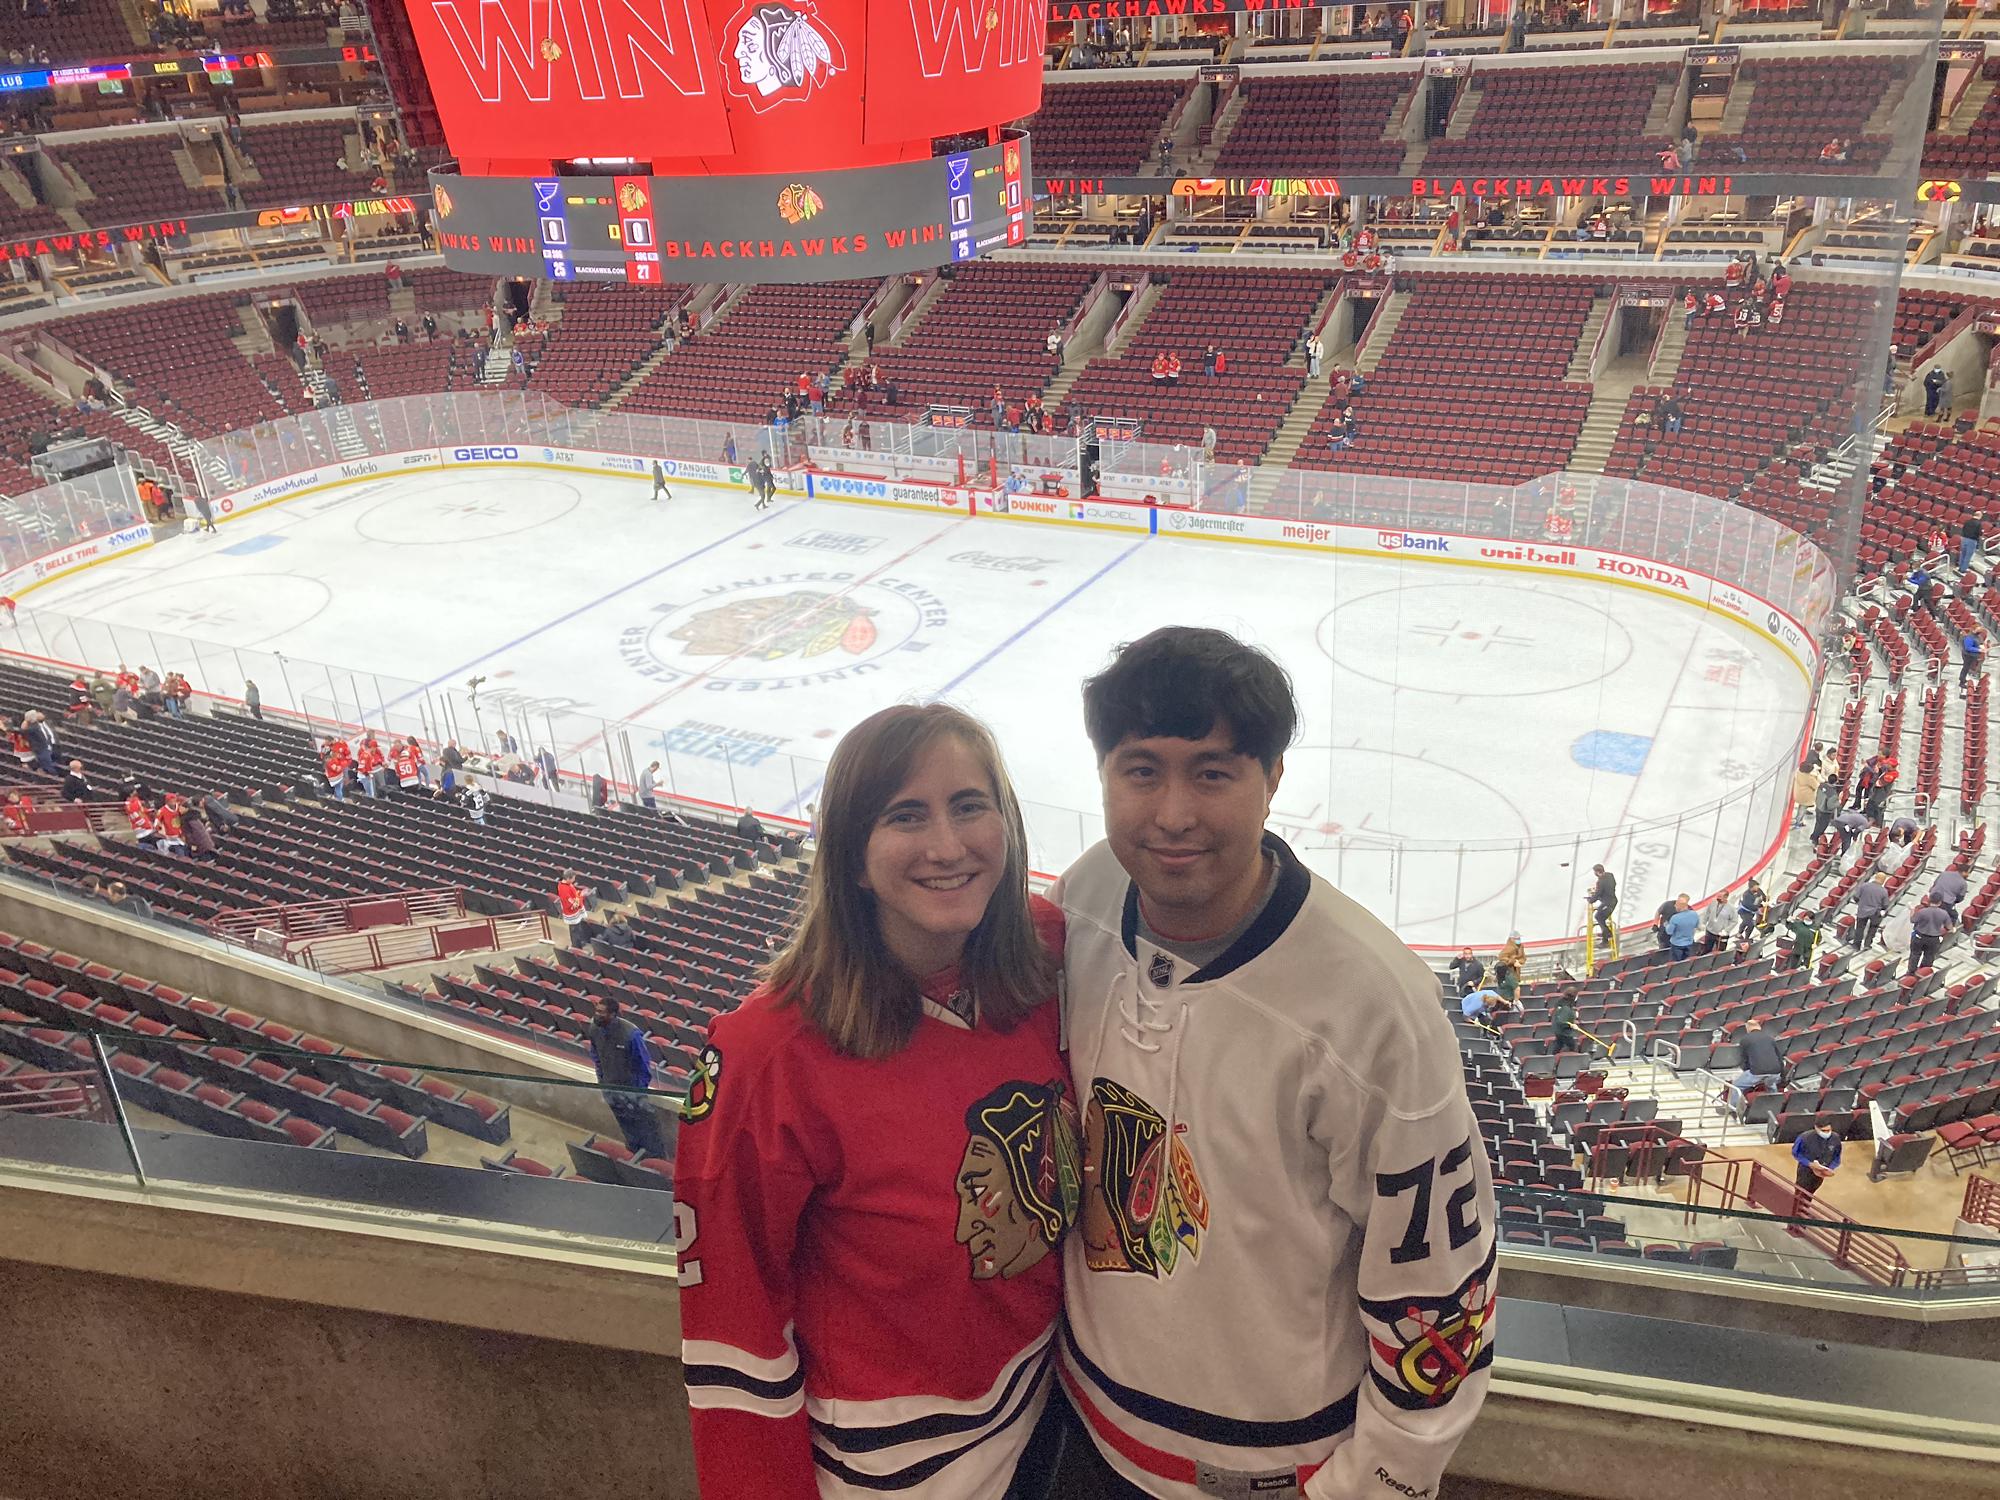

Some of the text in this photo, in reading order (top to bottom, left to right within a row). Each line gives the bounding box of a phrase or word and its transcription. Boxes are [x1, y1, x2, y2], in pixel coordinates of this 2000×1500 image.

[1051, 0, 1226, 20] LACKHAWKS
[432, 0, 705, 101] WIN
[1046, 179, 1104, 194] WIN!
[1411, 177, 1732, 195] BLACKHAWKS WIN!
[123, 220, 187, 241] WIN!
[488, 236, 536, 254] WIN!
[665, 234, 869, 257] BLACKHAWKS
[885, 223, 944, 248] WIN!
[553, 261, 650, 280] 25 BLACKHAWKS.COM 27
[454, 447, 519, 461] GEICO
[555, 452, 575, 463] AT&T
[341, 462, 378, 478] Modelo
[263, 474, 319, 498] MassMutual
[893, 487, 939, 502] guaranteed
[1011, 500, 1057, 513] DUNKIN'
[115, 527, 149, 545] North
[1282, 525, 1331, 542] meijer
[45, 545, 98, 571] BELLE TIRE
[1597, 557, 1691, 590] HONDA
[701, 571, 948, 628] UNITED CENTER
[399, 764, 413, 775] 50
[1376, 1136, 1482, 1264] 72
